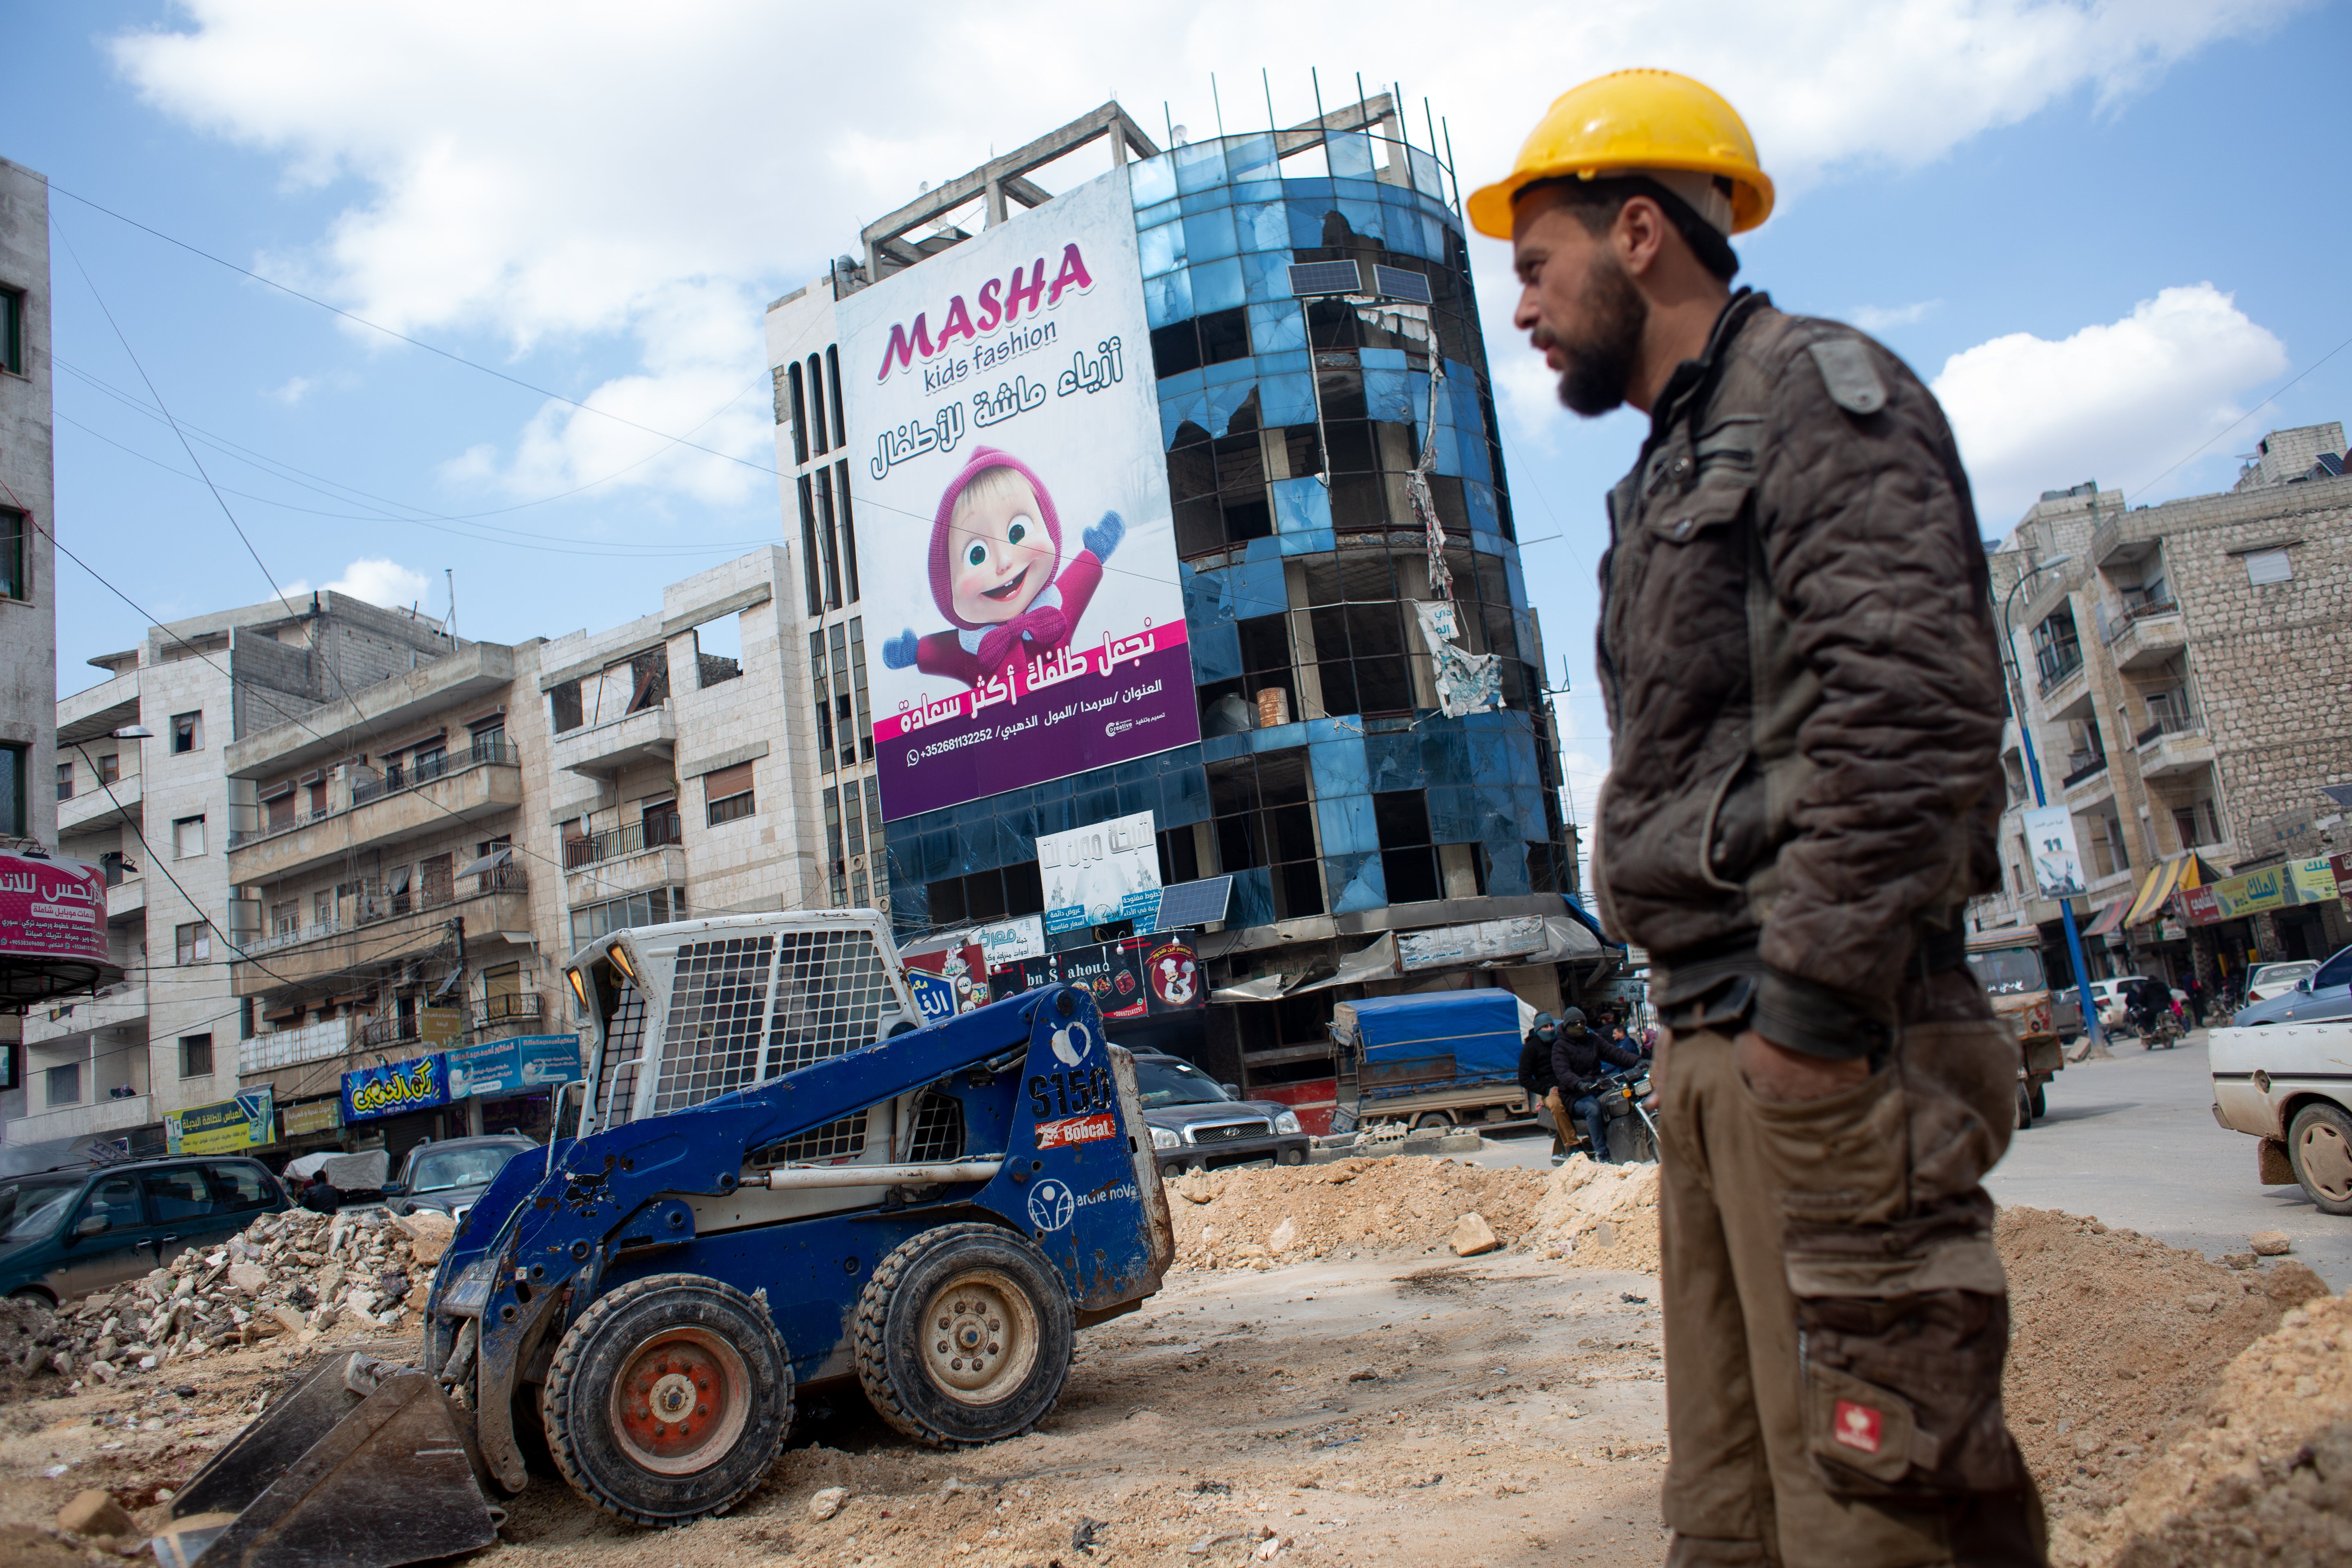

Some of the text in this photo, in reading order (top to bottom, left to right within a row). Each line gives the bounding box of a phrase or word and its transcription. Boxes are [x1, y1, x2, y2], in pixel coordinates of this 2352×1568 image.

[878, 243, 1093, 380] MASHA
[924, 321, 1057, 392] kids fashion
[871, 336, 1123, 481] أزياء ماشة للأطفال
[1098, 617, 1155, 677] نجعل
[971, 664, 1018, 720] أكثر
[1123, 679, 1162, 703] العنوان
[898, 693, 961, 733] سعادة
[920, 728, 993, 758] +352681132252
[2043, 837, 2063, 852] 11
[0, 872, 36, 894] للات
[1123, 890, 1162, 904] خطوط مفتوحة
[33, 905, 95, 919] خدمات موبايل شاملة
[1050, 906, 1081, 918] عروض دائمة
[1124, 907, 1136, 917] الأداء
[1137, 906, 1147, 915] في
[22, 919, 35, 929] تركي
[1050, 916, 1085, 931] أسعار مناسبة
[25, 930, 43, 938] صيانة
[1016, 936, 1028, 944] جملة
[1013, 945, 1029, 957] أدوات
[1028, 1067, 1112, 1119] S150
[202, 1112, 222, 1125] للطاقة
[223, 1107, 243, 1124] العباس
[1064, 1120, 1110, 1142] Bobcat
